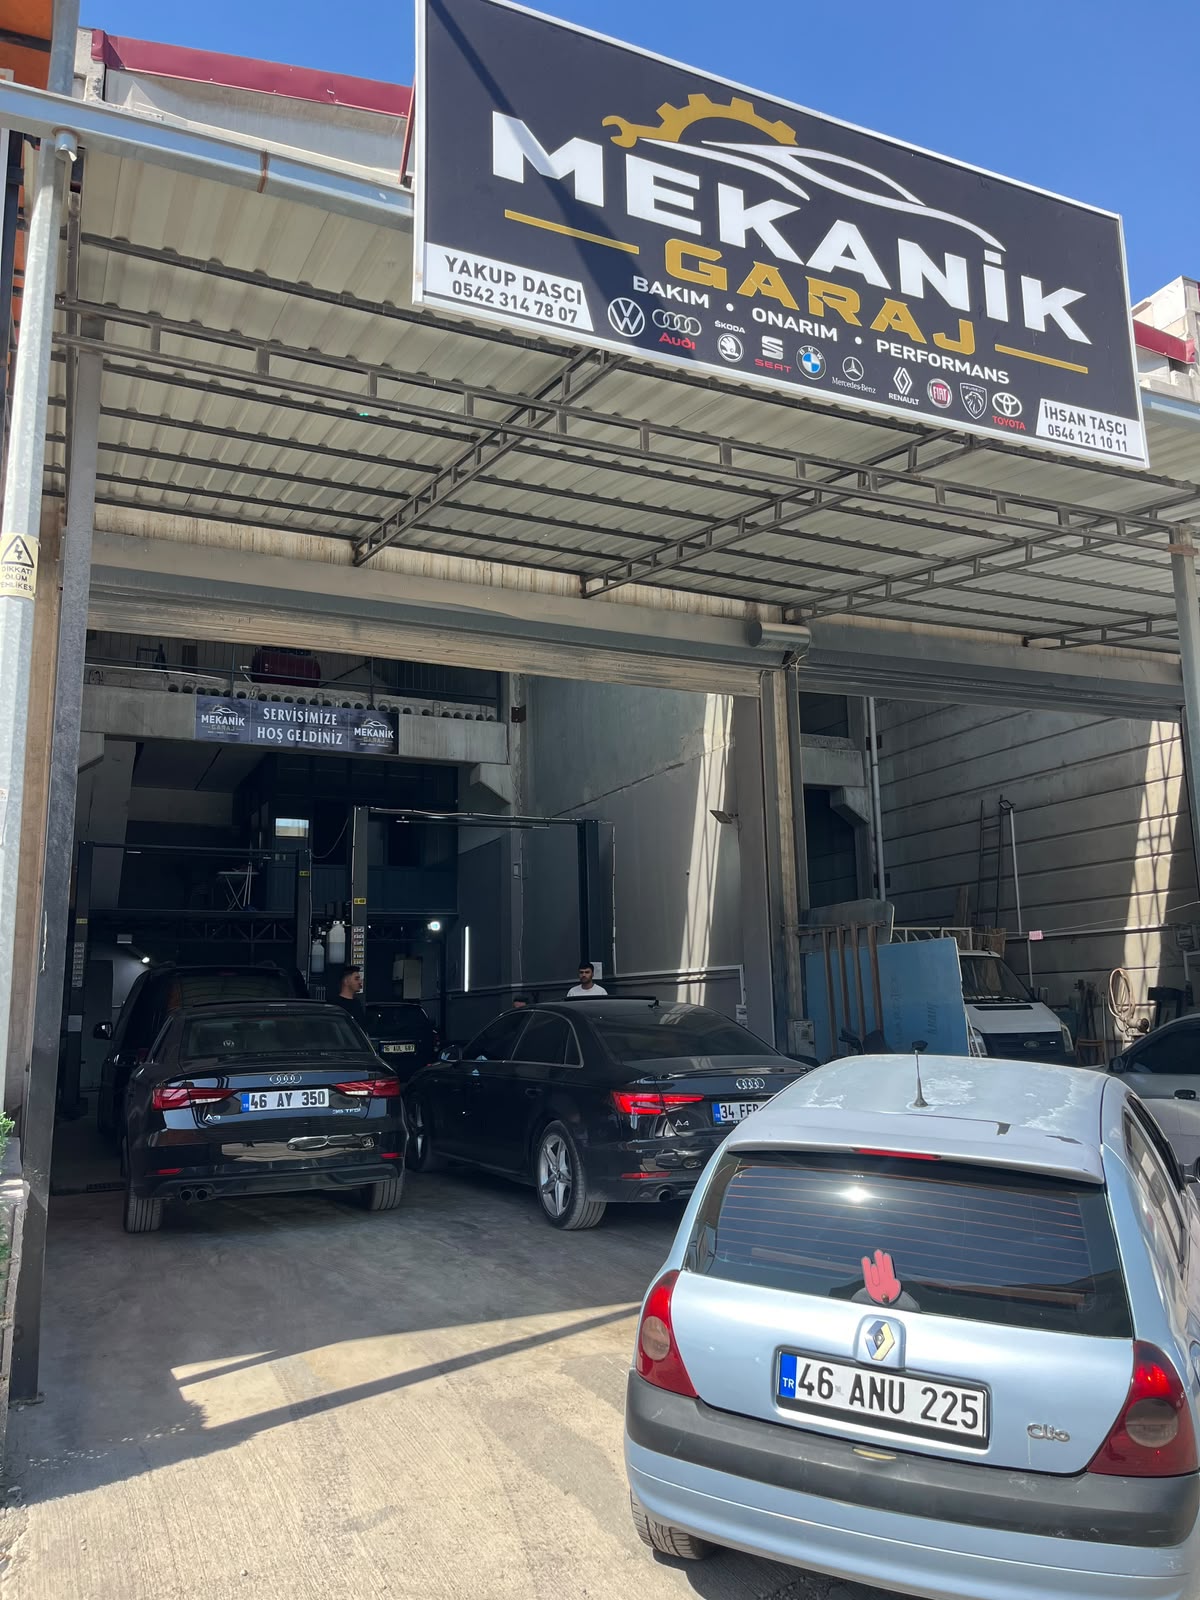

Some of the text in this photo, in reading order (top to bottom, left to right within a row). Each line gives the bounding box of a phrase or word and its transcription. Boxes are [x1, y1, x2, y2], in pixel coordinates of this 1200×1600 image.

[493, 111, 1092, 345] MEKANİK
[444, 254, 582, 306] YAKUP DAŞCI
[452, 279, 578, 324] 0542 314 78 07
[665, 238, 976, 355] GARAJ
[633, 275, 1010, 385] BAKIM ONARIM PERFORMANS
[658, 332, 696, 351] Audi
[798, 346, 823, 361] BMW
[754, 358, 792, 374] SEAT
[831, 376, 877, 395] Mercedes-Benz
[932, 386, 948, 402] FIAT
[888, 392, 920, 406] RENAULT
[992, 415, 1026, 431] TOYOTA
[1044, 401, 1127, 437] İHSAN TAŞCI
[1048, 424, 1127, 453] 0546 121 10 11
[201, 714, 245, 727] MEKANİK
[263, 707, 338, 726] SERVİSİMİZE
[257, 727, 343, 745] HOŞ GELDİNİZ
[354, 727, 395, 740] MEKANİK
[250, 1094, 268, 1109] 46
[276, 1092, 293, 1107] AY
[301, 1091, 326, 1106] 350
[204, 1113, 221, 1121] A3
[721, 1104, 735, 1119] 34
[675, 1119, 690, 1127] A4
[782, 1362, 979, 1430] TR 46 ANU 225
[1026, 1422, 1070, 1442] Clio
